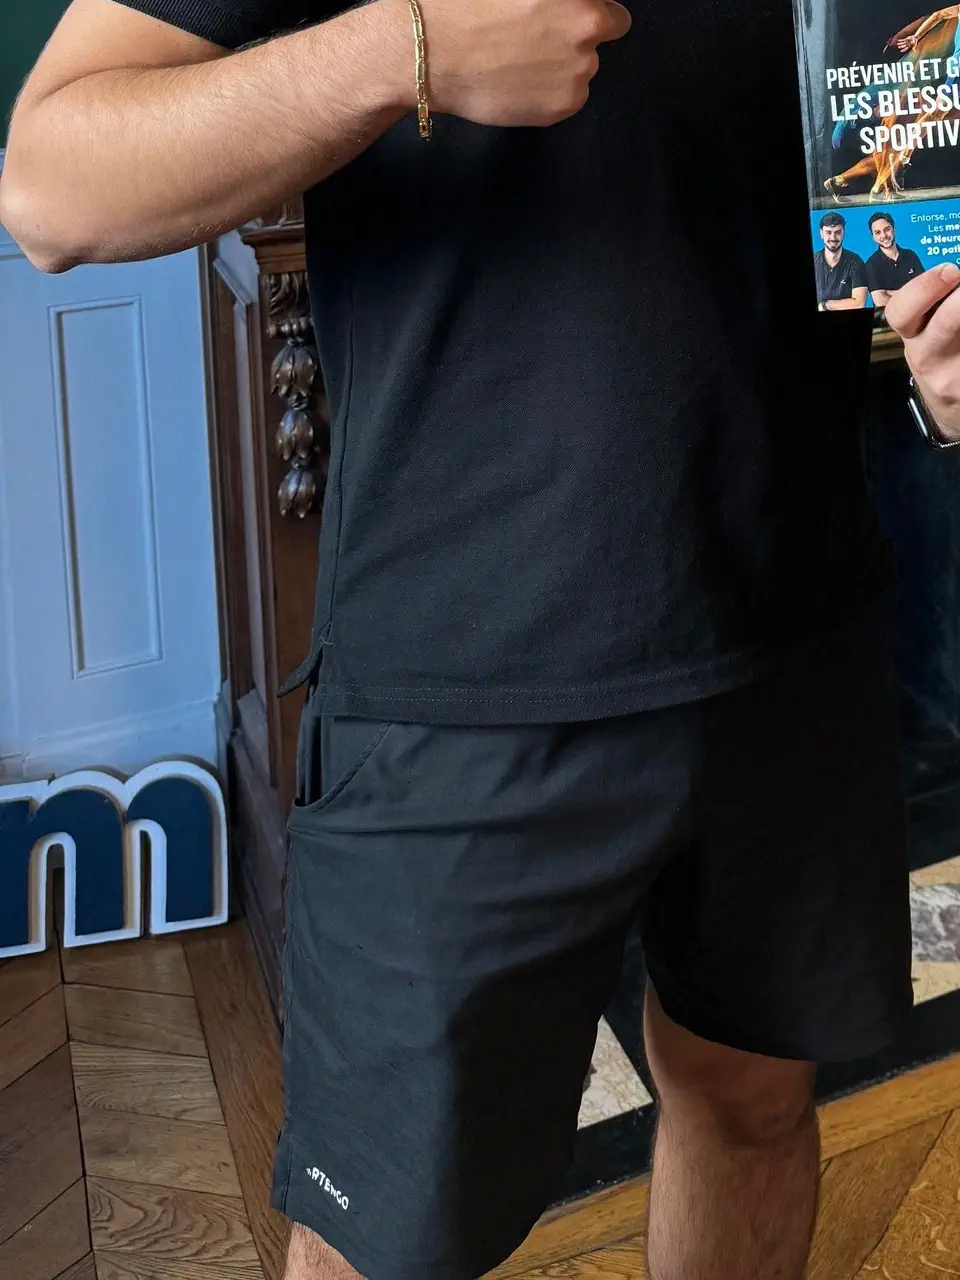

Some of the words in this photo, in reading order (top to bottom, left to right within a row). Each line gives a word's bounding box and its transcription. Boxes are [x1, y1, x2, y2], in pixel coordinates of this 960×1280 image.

[825, 61, 915, 90] PRÉVENIR
[918, 58, 943, 81] ET
[830, 91, 873, 122] LES
[910, 213, 947, 223] Entorse,
[928, 223, 944, 233] Les
[920, 235, 932, 245] de
[926, 246, 940, 256] 20
